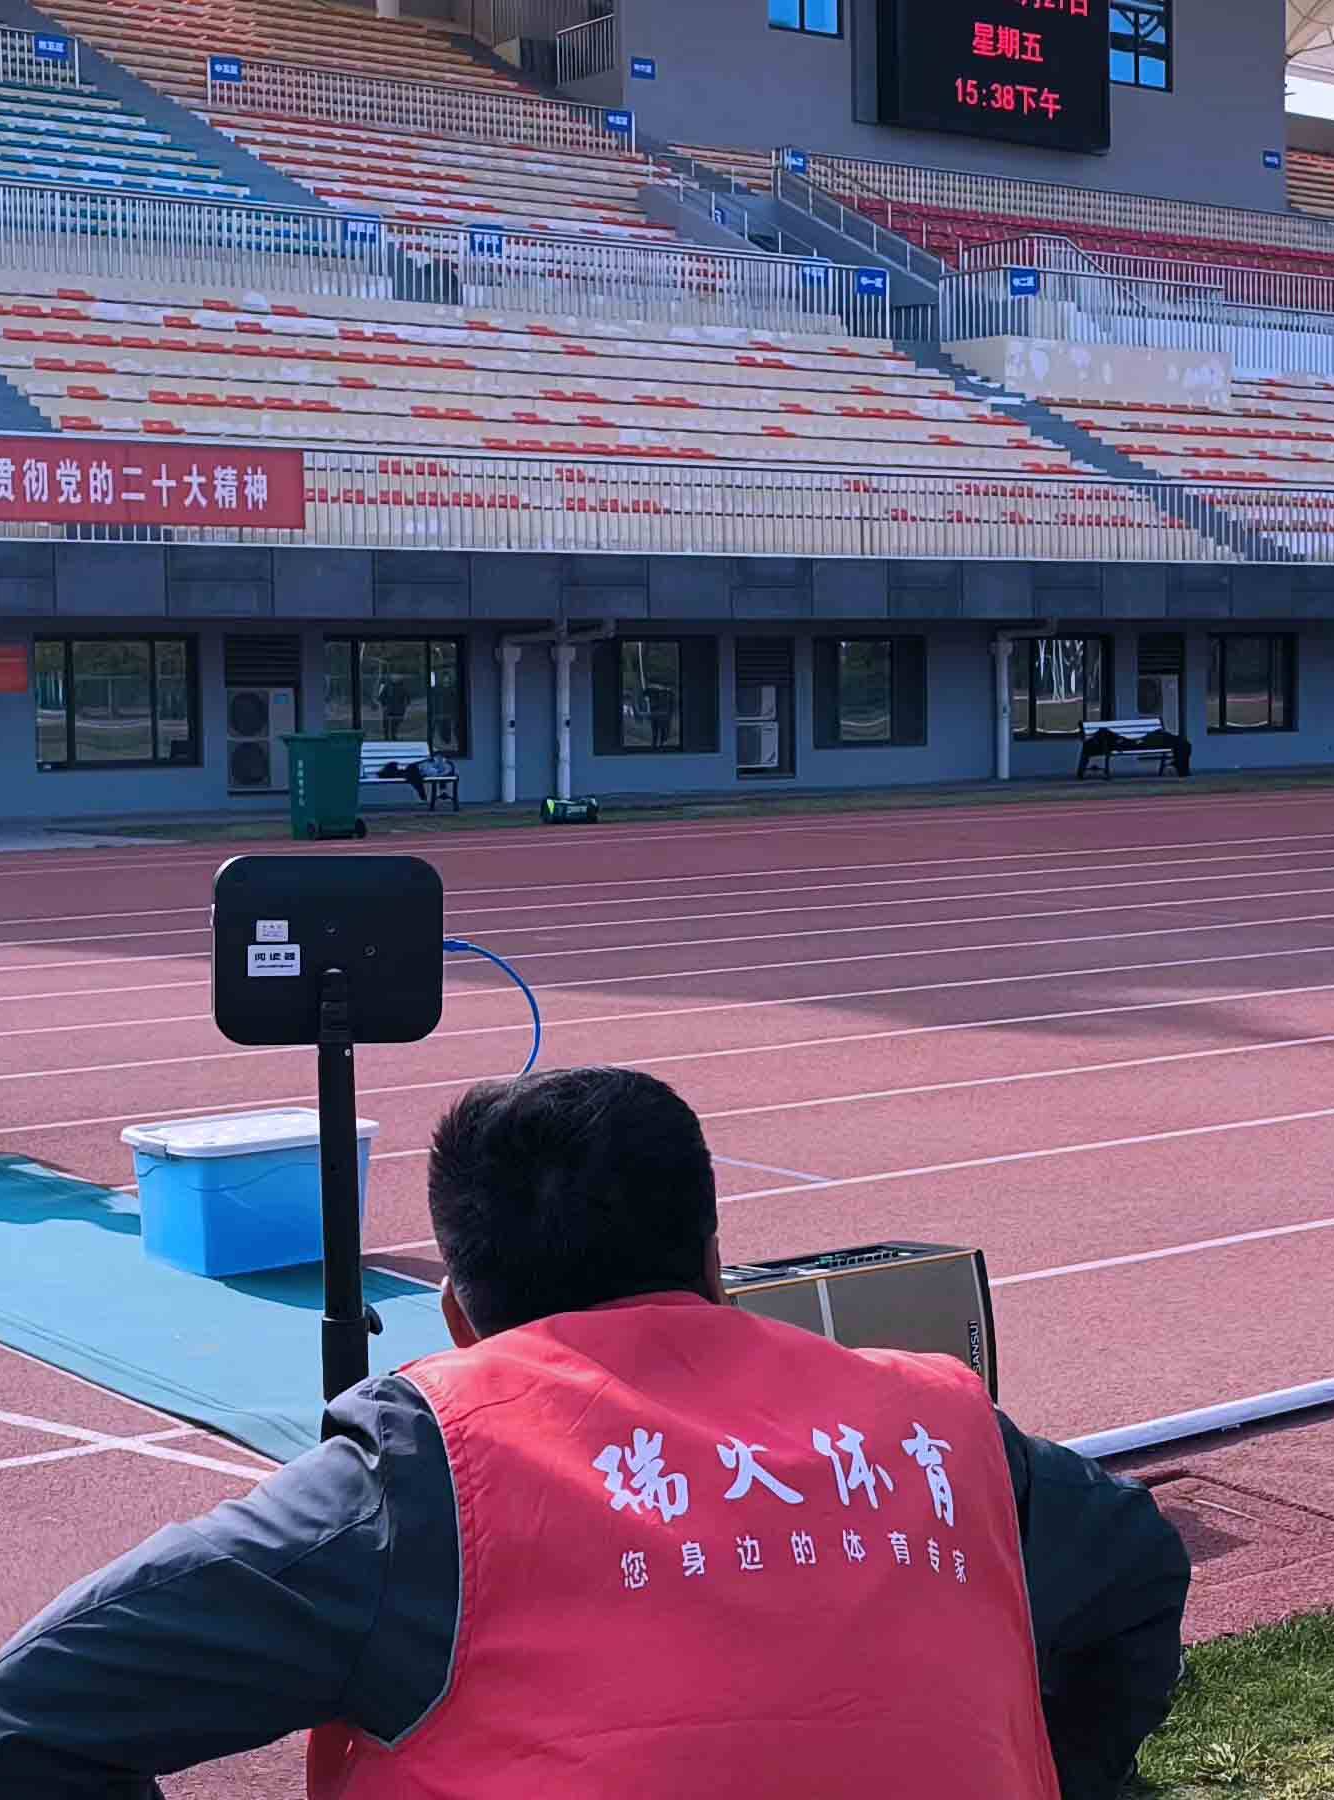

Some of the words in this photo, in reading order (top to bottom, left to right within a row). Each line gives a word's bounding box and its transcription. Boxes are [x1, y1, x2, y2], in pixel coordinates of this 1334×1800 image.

[971, 22, 1044, 62] 星期五
[954, 77, 1062, 120] 15:38下午
[592, 1422, 954, 1527] 瑞火体育
[620, 1528, 967, 1590] 您身边的体育专家
